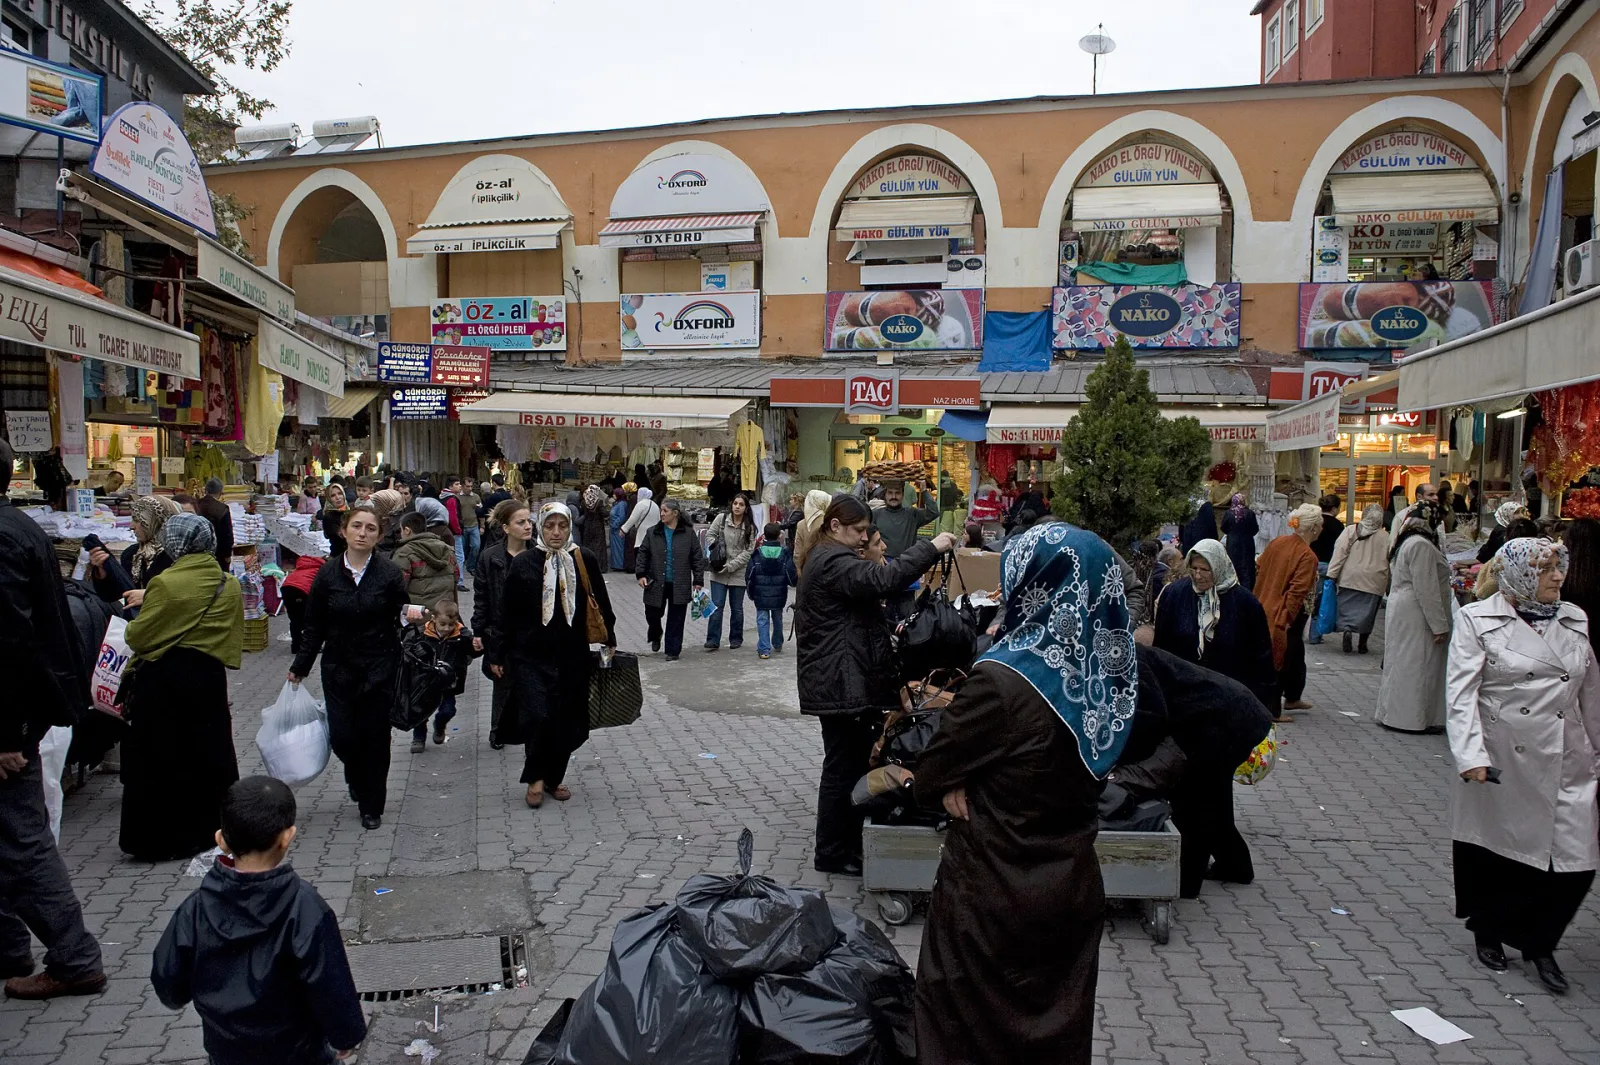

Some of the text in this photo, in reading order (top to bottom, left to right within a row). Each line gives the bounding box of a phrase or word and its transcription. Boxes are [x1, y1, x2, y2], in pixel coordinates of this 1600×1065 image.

[1342, 132, 1466, 171] NAKO EL ÖRGÜ YÜNLERİ
[130, 150, 153, 170] HAVLU
[1089, 144, 1203, 185] NAKO EL ÖRGÜ YÜNLERİ
[1359, 153, 1447, 168] GÜLÜM YÜN
[859, 156, 961, 194] NAKO EL ÖRGÜ YÜNLERİ
[1113, 168, 1178, 183] GÜLÜM YÜN
[668, 180, 707, 188] OXFORD
[880, 179, 939, 193] GÜLÜM YÜN
[1093, 220, 1125, 230] NAKO
[1178, 216, 1201, 227] YÜN
[1357, 209, 1476, 224] NAKO GÜLÜM YÜN
[644, 233, 702, 244] OXFORD
[853, 226, 950, 239] NAKO GÜLÜM YÜN
[219, 266, 241, 293] HAVLU
[1119, 308, 1170, 322] NAKO
[467, 322, 527, 335] EL ÖRGÜ İPLERİ
[673, 317, 735, 330] OXFORD
[886, 325, 917, 334] NAKO
[1380, 319, 1419, 329] NAKO
[68, 324, 87, 348] TÜL
[391, 344, 430, 354] GÜNGÖRDÜ
[404, 387, 447, 395] GÜNGÖRDÜ
[933, 396, 975, 405] NAZ HOME
[574, 413, 616, 428] İPLİK
[625, 419, 645, 429] No:
[649, 420, 662, 429] 13
[1001, 429, 1017, 441] No:
[1020, 429, 1029, 440] 11
